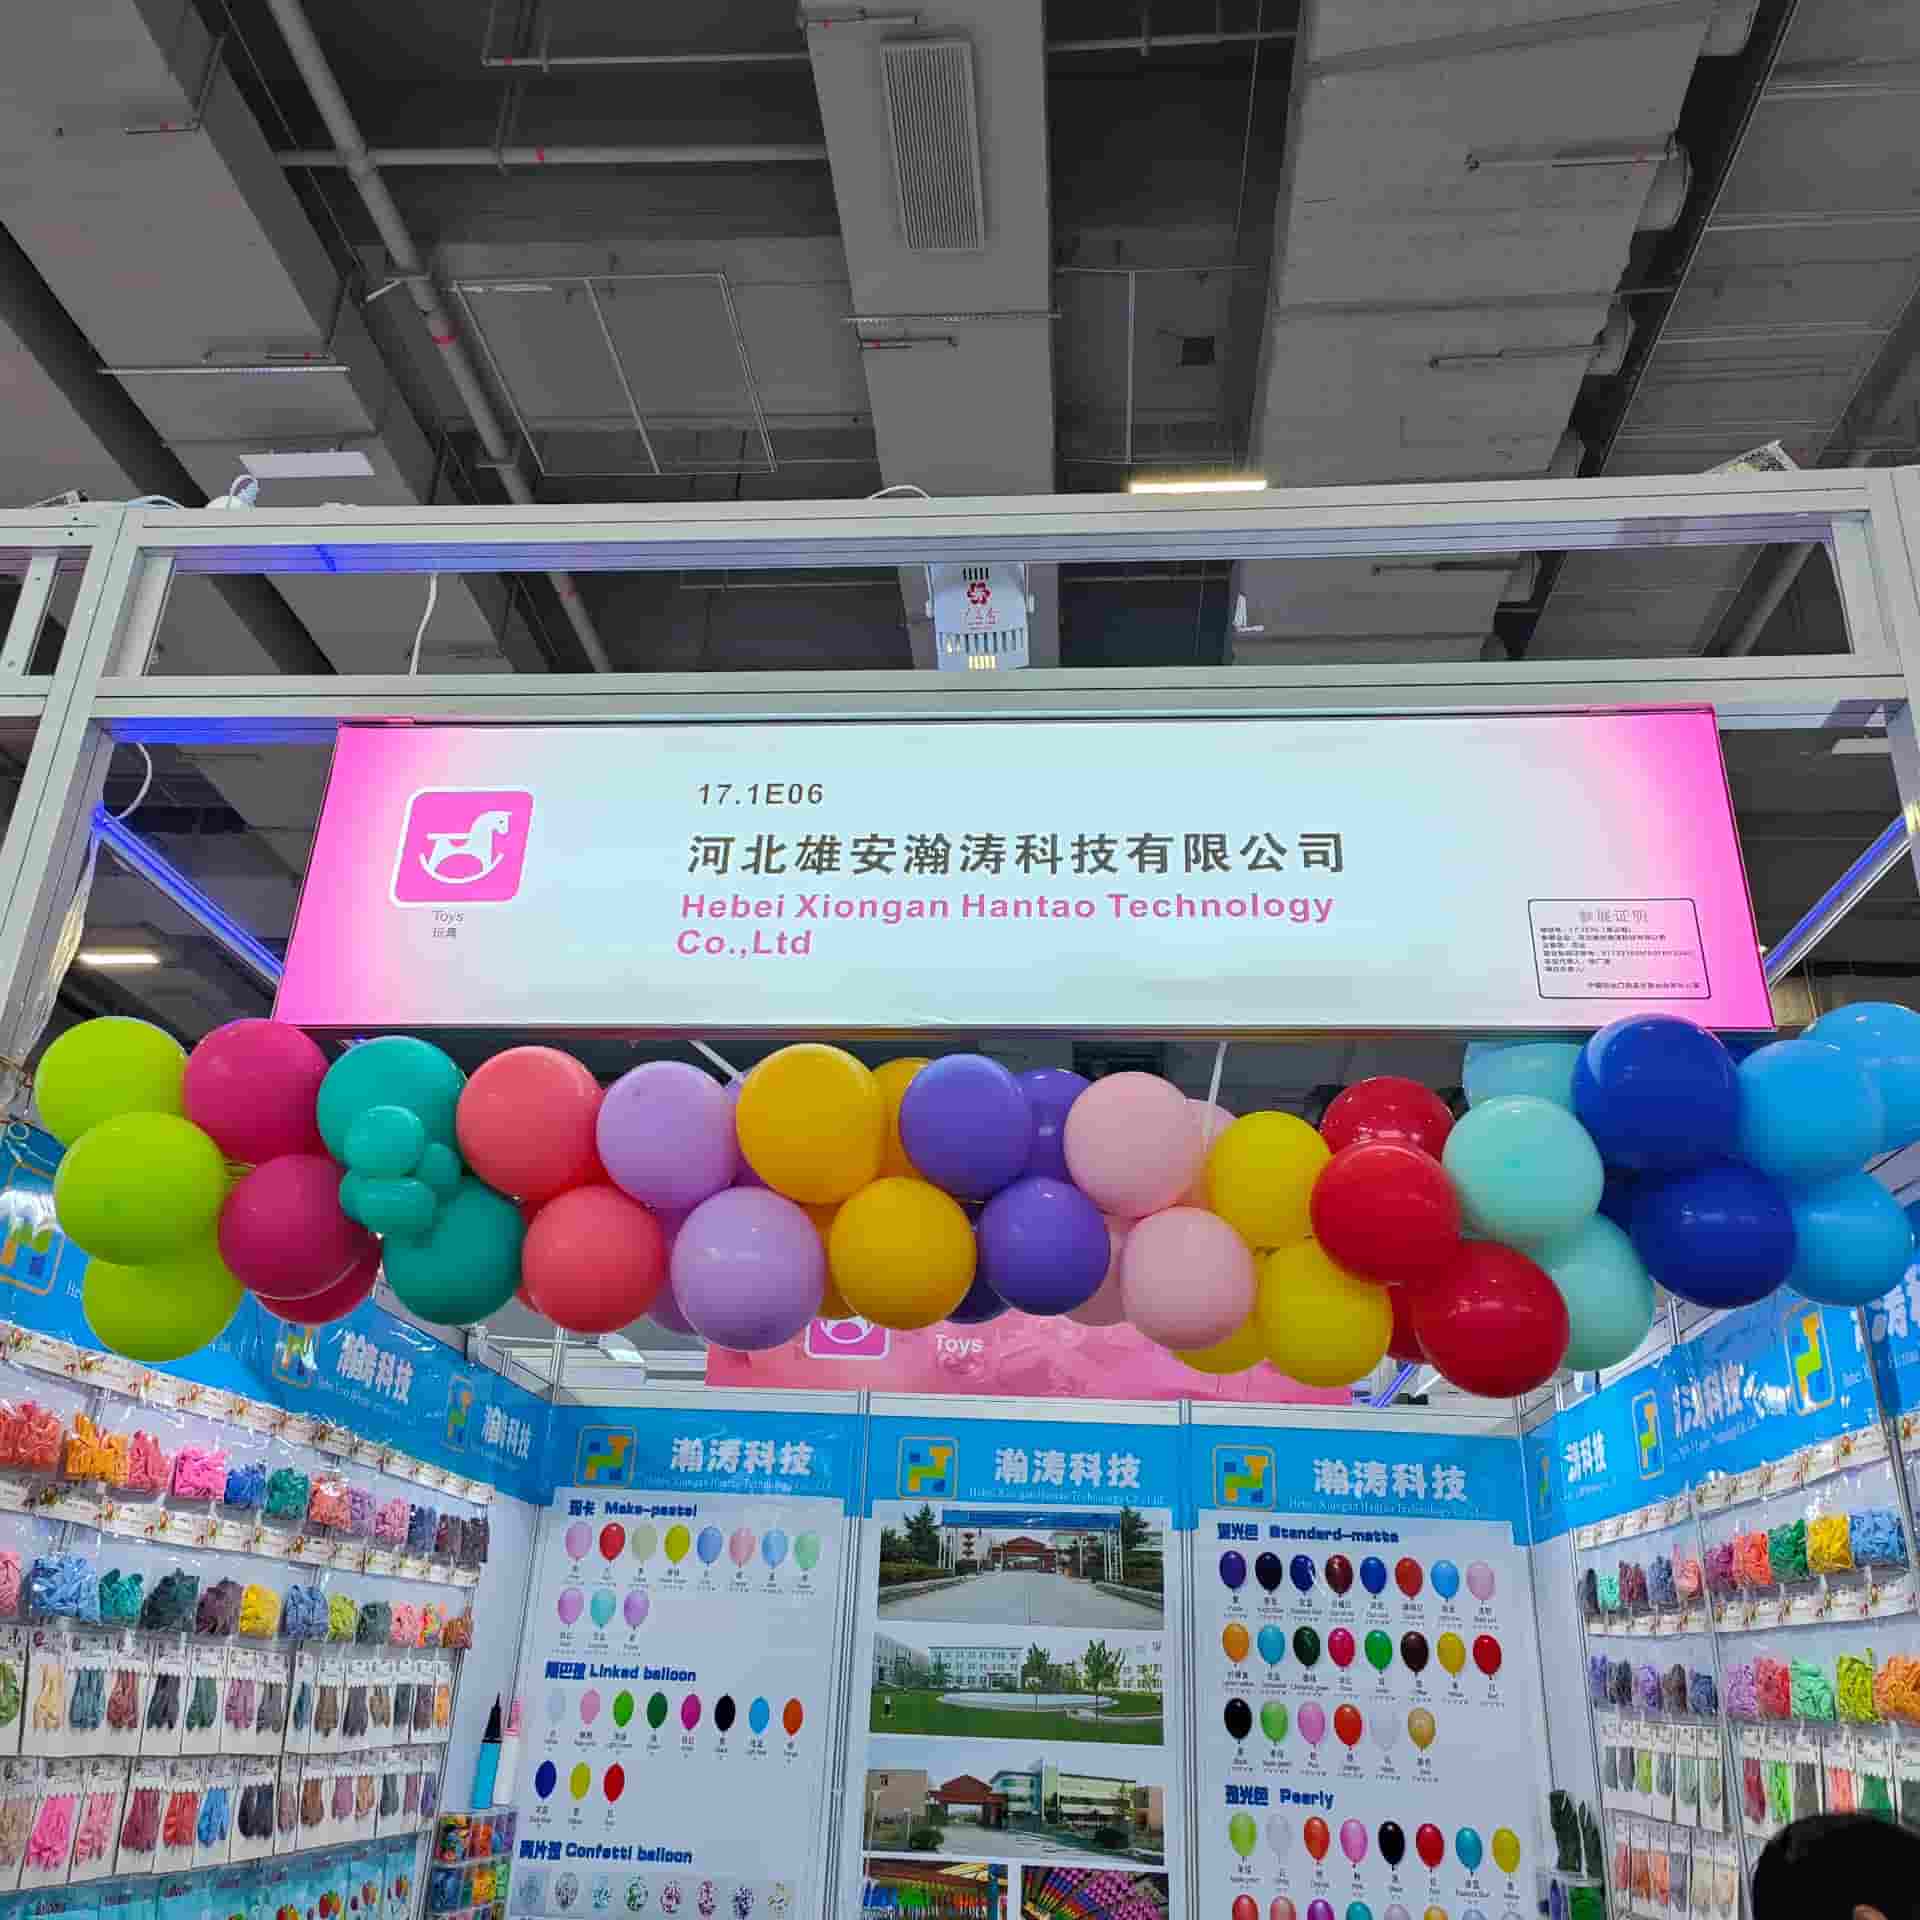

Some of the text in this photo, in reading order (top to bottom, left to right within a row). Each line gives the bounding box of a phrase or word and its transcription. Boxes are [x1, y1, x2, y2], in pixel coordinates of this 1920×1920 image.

[697, 783, 824, 805] 17.1E06
[688, 832, 1344, 875] 河北雄安瀚涛科技有限公司
[432, 910, 465, 925] Toys
[681, 892, 1334, 925] Hebei Xiongan Hantao Technology
[676, 929, 812, 957] Co.,Ltd
[935, 1333, 985, 1356] Toys
[671, 1437, 815, 1476] 瀚涛科技
[994, 1448, 1141, 1489] 瀚涛科技
[1312, 1457, 1467, 1501] 瀚涛科技
[589, 1663, 640, 1680] Linked
[643, 1666, 697, 1682] balloon
[1280, 1787, 1335, 1810] Pearly
